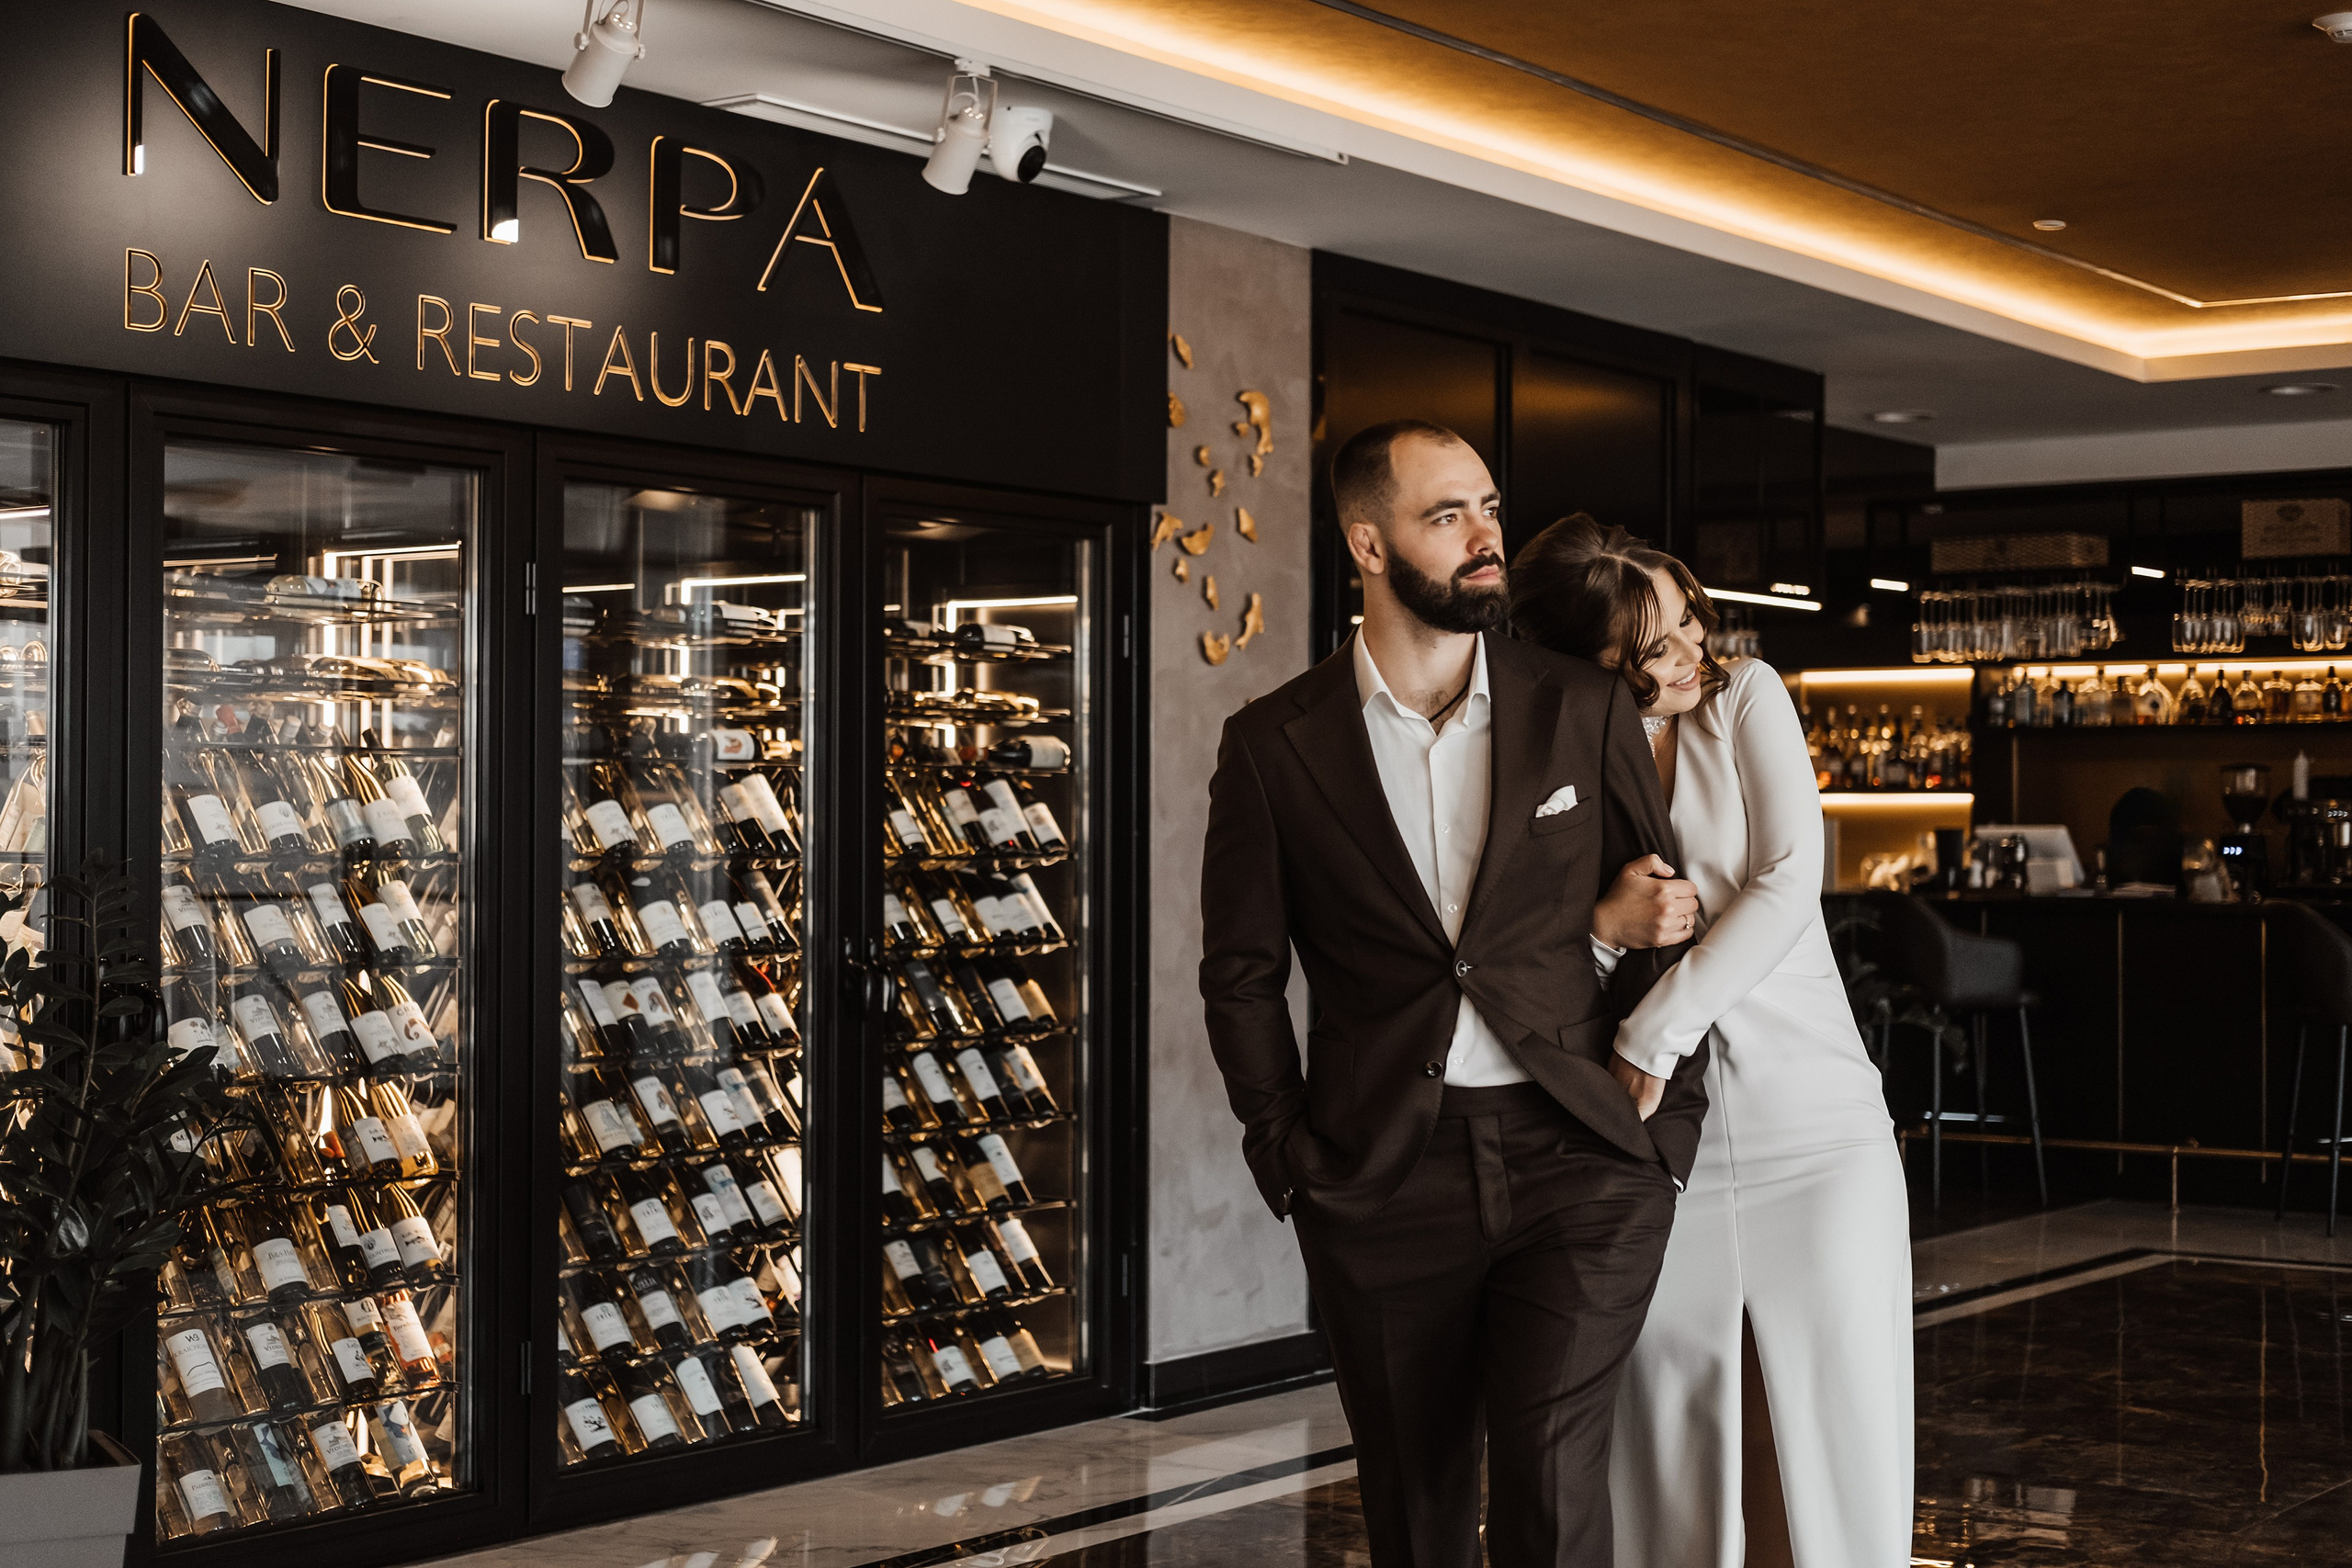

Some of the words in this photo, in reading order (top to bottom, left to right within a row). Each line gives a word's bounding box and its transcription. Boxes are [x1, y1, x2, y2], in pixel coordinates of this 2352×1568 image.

[123, 11, 883, 313] NERPA
[124, 247, 296, 353] BAR
[328, 284, 380, 365] &
[417, 293, 883, 433] RESTAURANT
